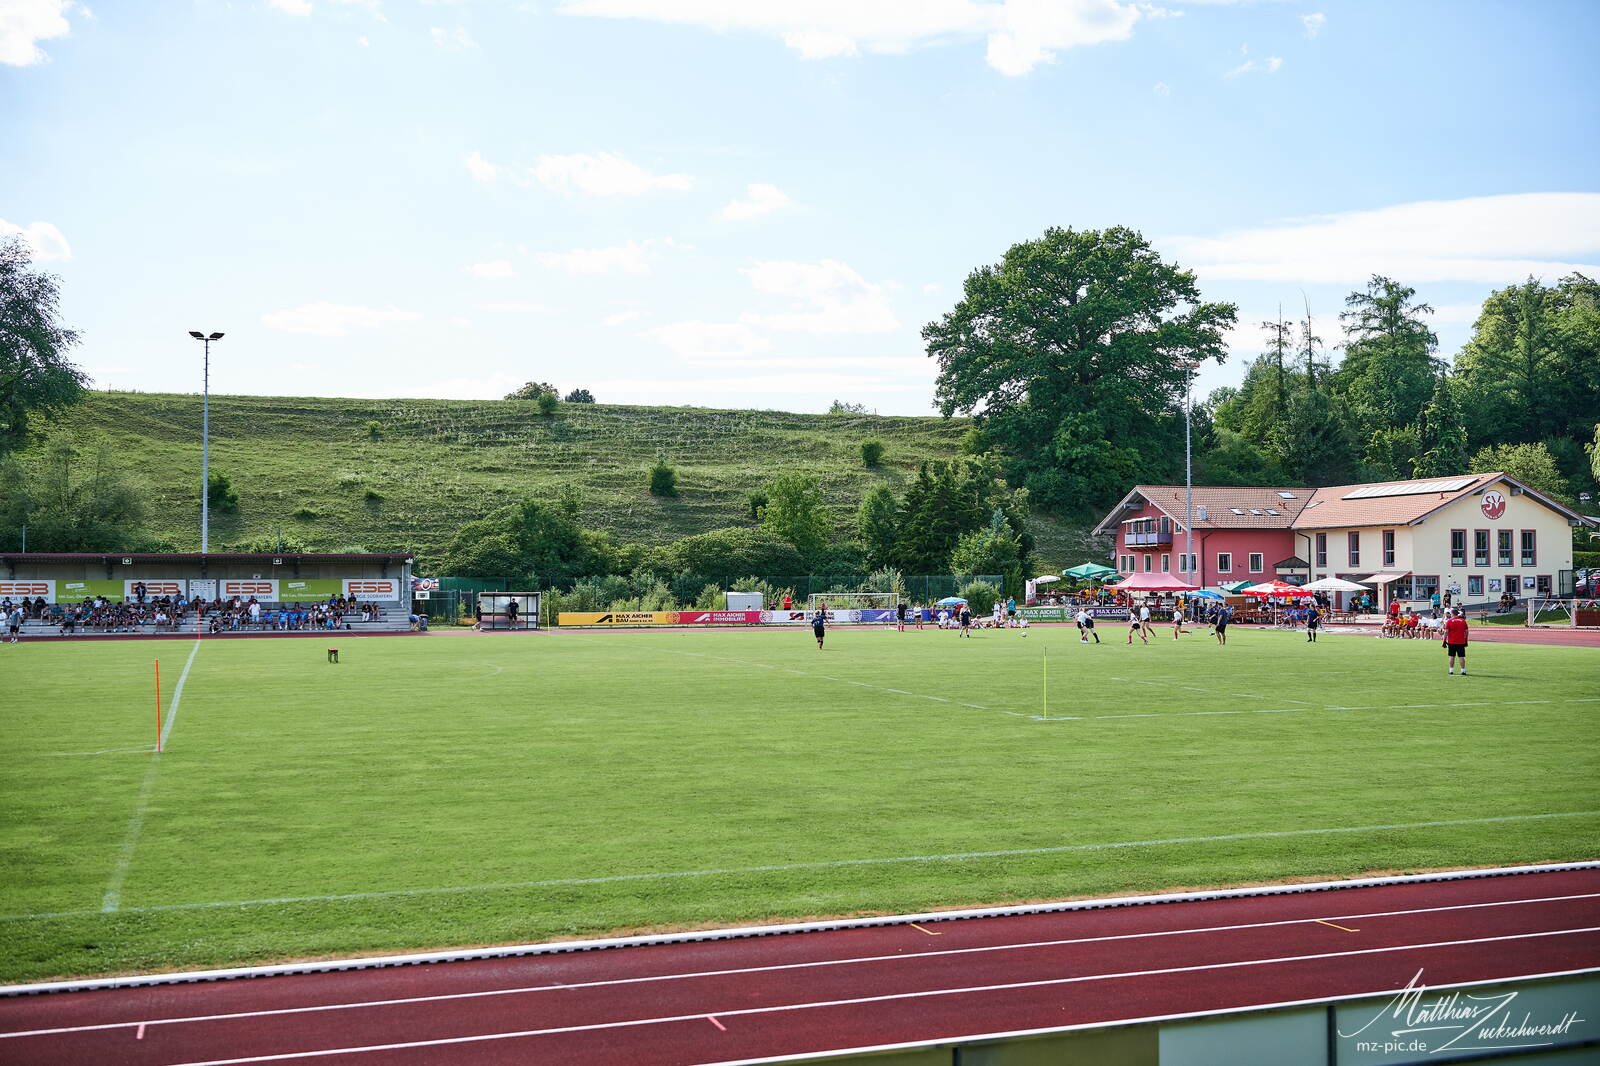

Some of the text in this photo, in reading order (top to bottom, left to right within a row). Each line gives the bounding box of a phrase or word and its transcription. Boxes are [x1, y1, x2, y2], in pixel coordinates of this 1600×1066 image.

[1486, 496, 1502, 510] SV
[225, 582, 273, 594] ESB
[348, 582, 393, 593] ESB
